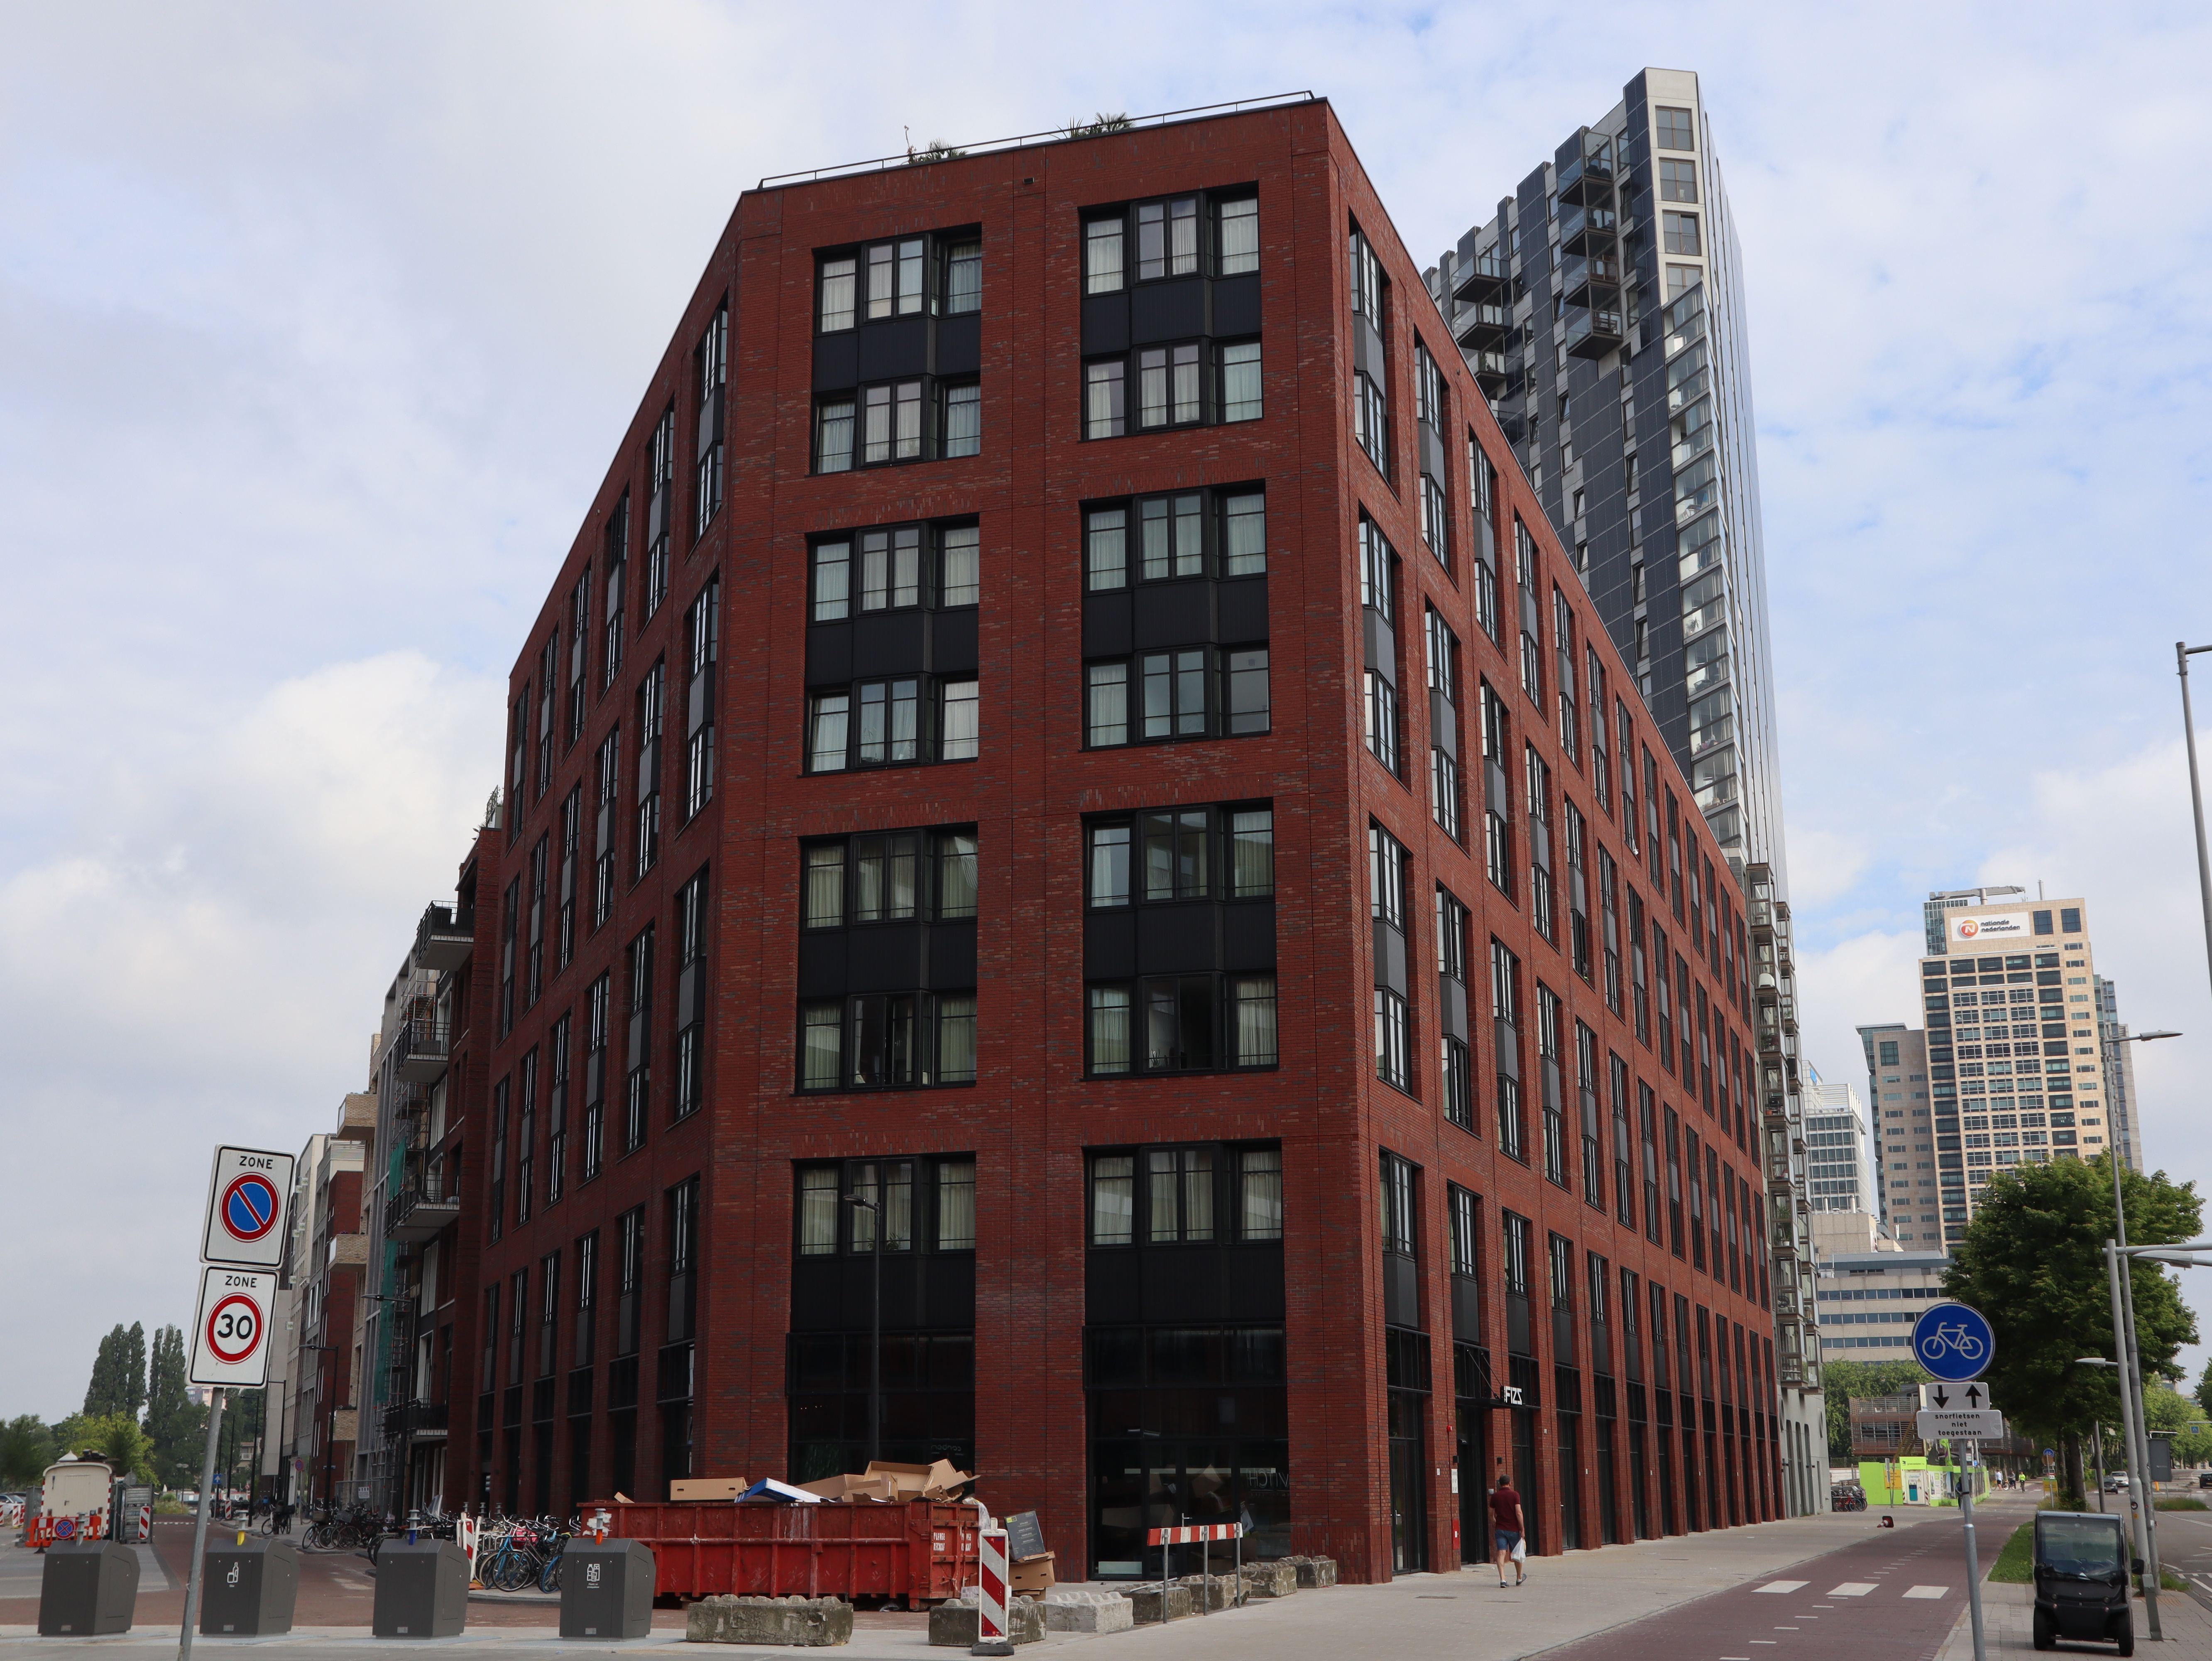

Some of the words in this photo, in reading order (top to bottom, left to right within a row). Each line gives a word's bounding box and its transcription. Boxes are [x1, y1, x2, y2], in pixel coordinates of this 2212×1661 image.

[239, 1156, 273, 1169] ZONE
[225, 1275, 257, 1288] ZONE
[217, 1314, 253, 1339] 30
